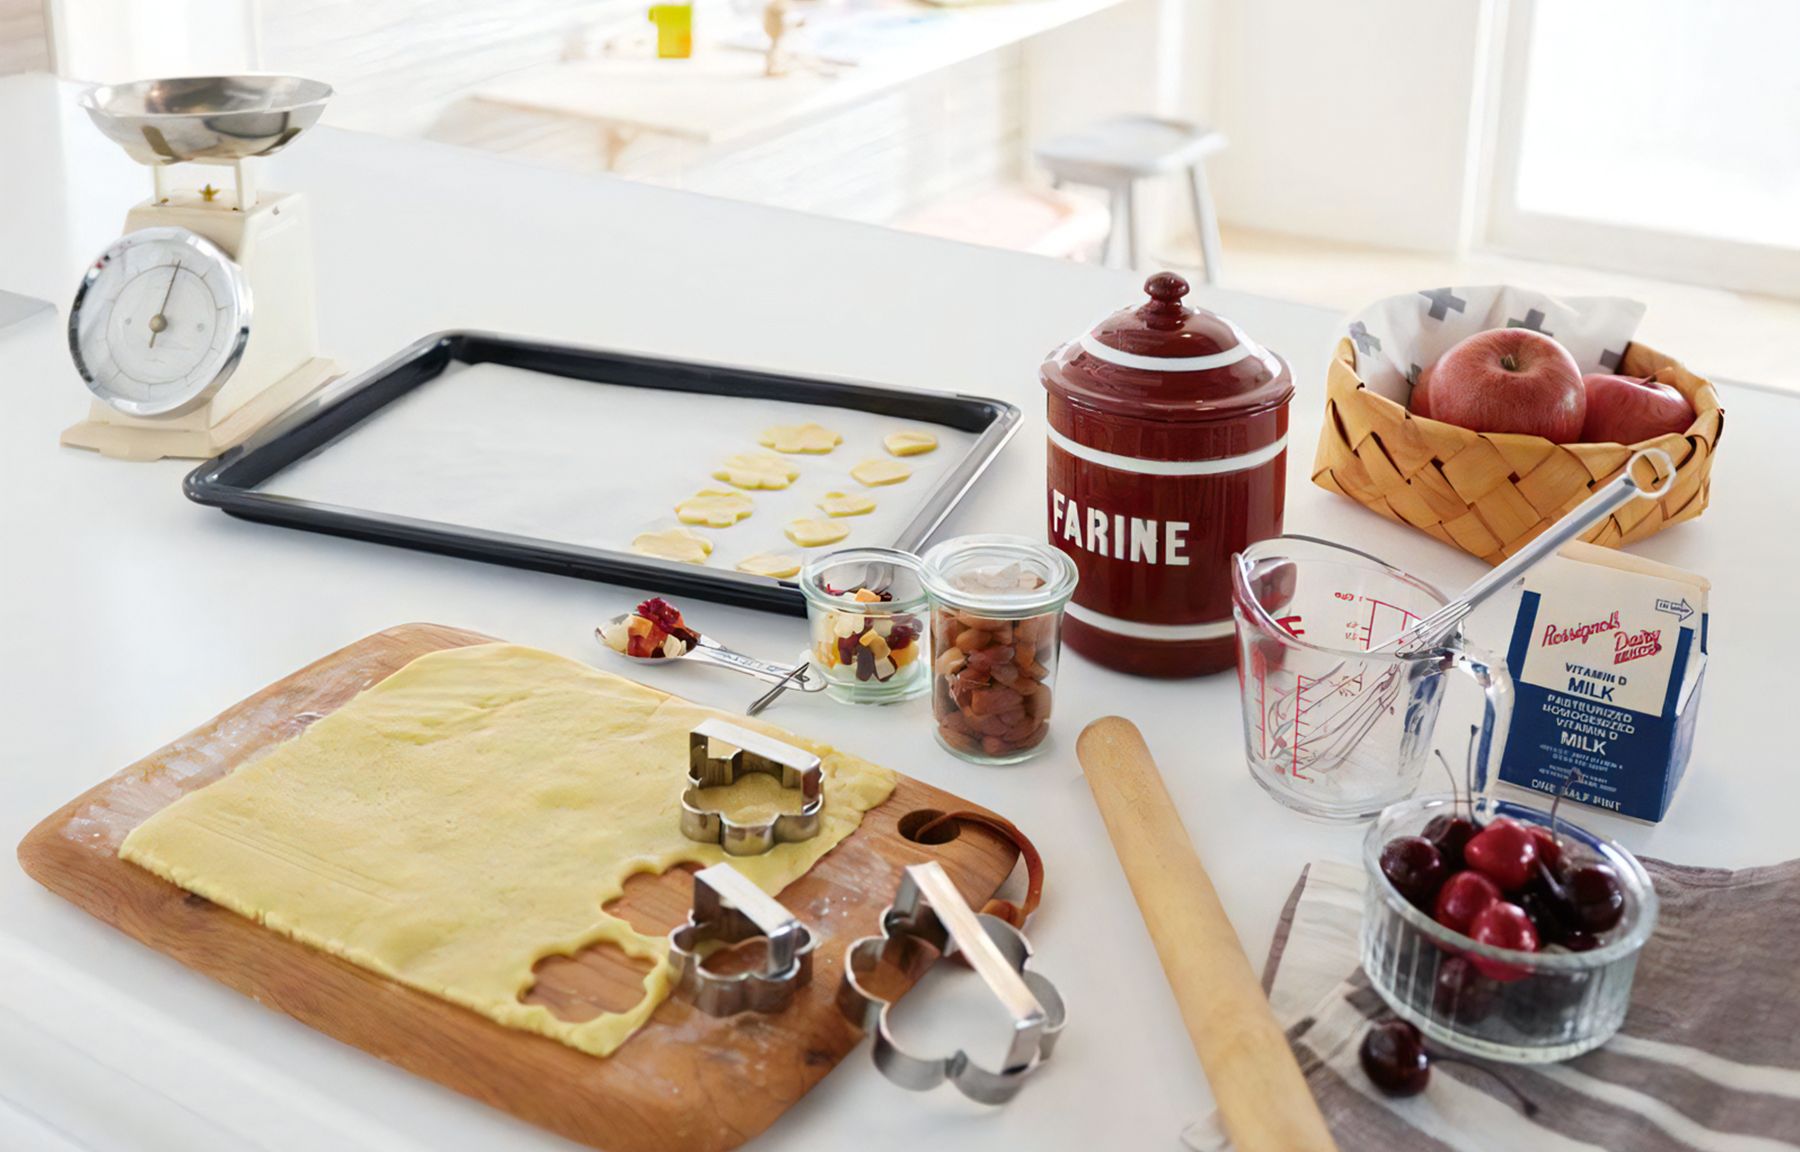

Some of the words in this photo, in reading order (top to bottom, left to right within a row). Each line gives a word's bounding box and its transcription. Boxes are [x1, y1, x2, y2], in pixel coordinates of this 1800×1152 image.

[1053, 489, 1190, 566] FARINE
[1565, 662, 1616, 683] VITAMIN
[1618, 676, 1627, 686] D
[1567, 677, 1615, 702] MILK
[1560, 731, 1606, 755] MILK
